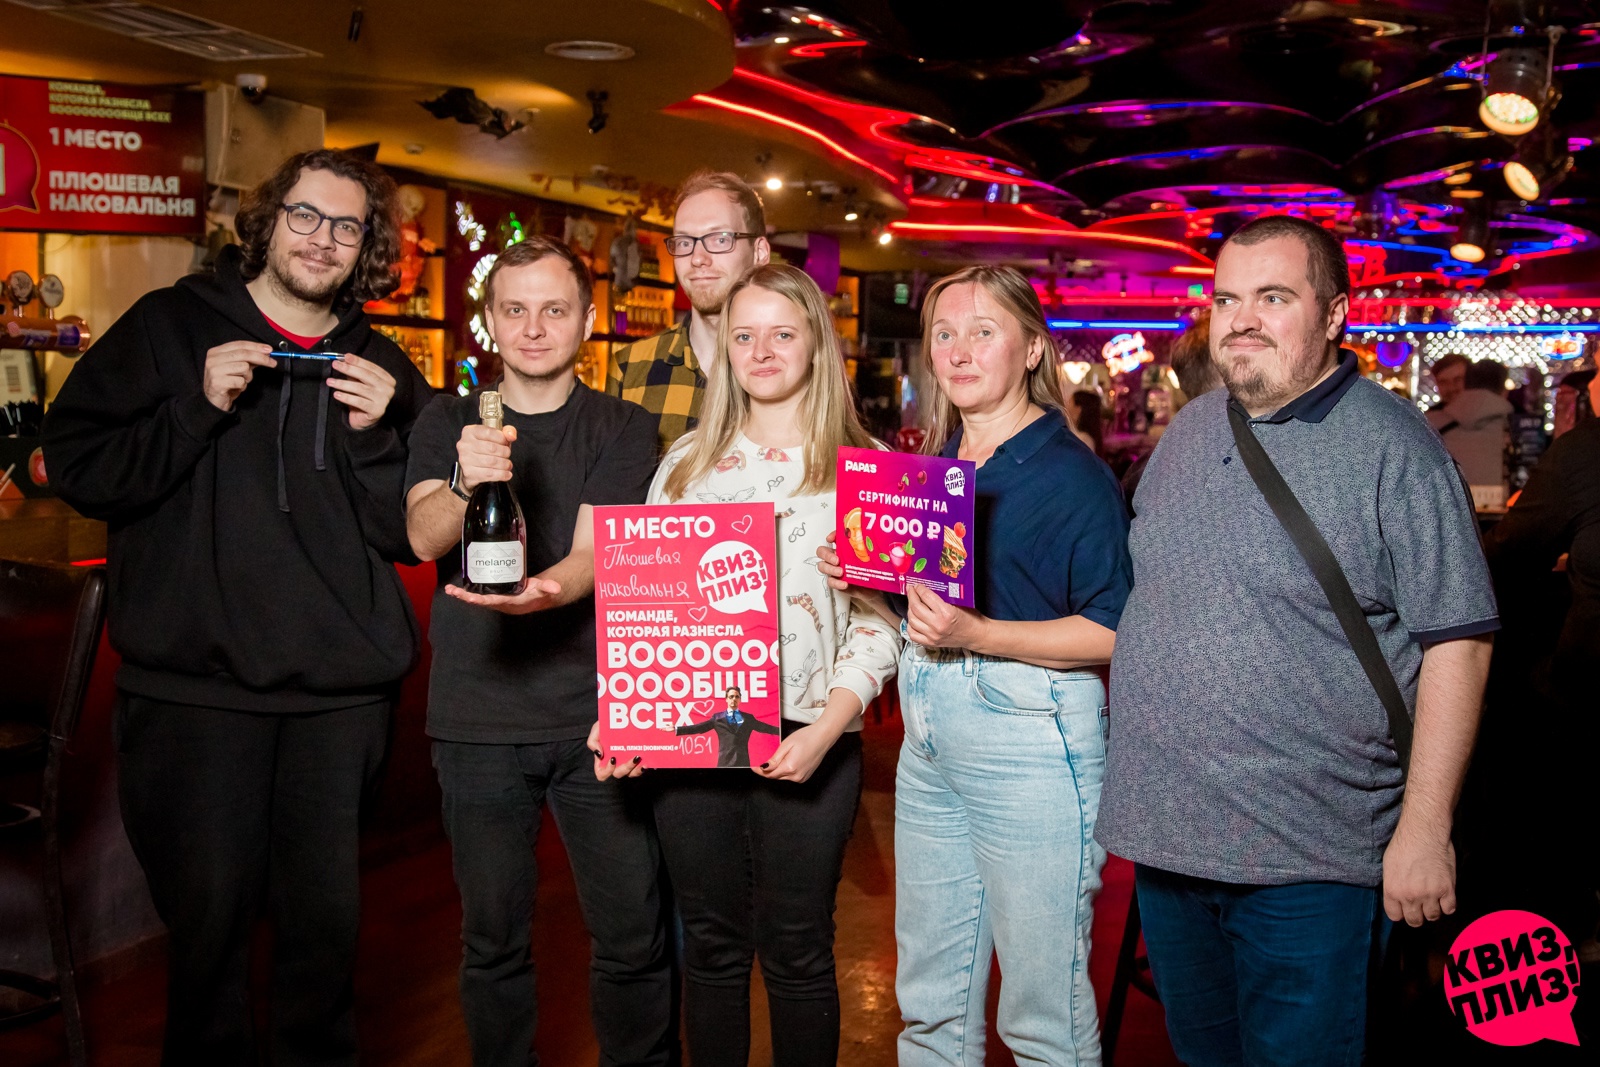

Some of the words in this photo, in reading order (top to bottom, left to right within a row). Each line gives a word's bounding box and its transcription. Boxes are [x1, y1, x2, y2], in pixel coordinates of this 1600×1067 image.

[48, 92, 97, 105] КОТОРАЯ
[98, 97, 151, 110] РАЗНЕСЛА
[145, 111, 171, 123] ВСЕХ
[49, 127, 60, 146] 1
[64, 128, 142, 151] МЕСТО
[49, 170, 180, 195] ПЛЮШЕВАЯ
[49, 192, 196, 217] НАКОВАЛЬНЯ
[858, 490, 929, 511] СЕРТИФИКАТ
[932, 500, 948, 513] НА
[605, 517, 616, 540] 1
[624, 515, 716, 540] МЕСТО
[475, 558, 517, 567] melange
[603, 541, 681, 570] Плюшевая
[698, 549, 766, 584] КВИЗ,
[599, 574, 690, 600] наковальня
[701, 569, 769, 604] ПЛИЗ!
[606, 610, 678, 624] КОМАНДЕ,
[606, 626, 670, 638] КОТОРАЯ
[672, 624, 744, 637] РАЗНЕСЛА
[609, 701, 695, 730] ВСЕХ
[679, 735, 713, 755] 1051
